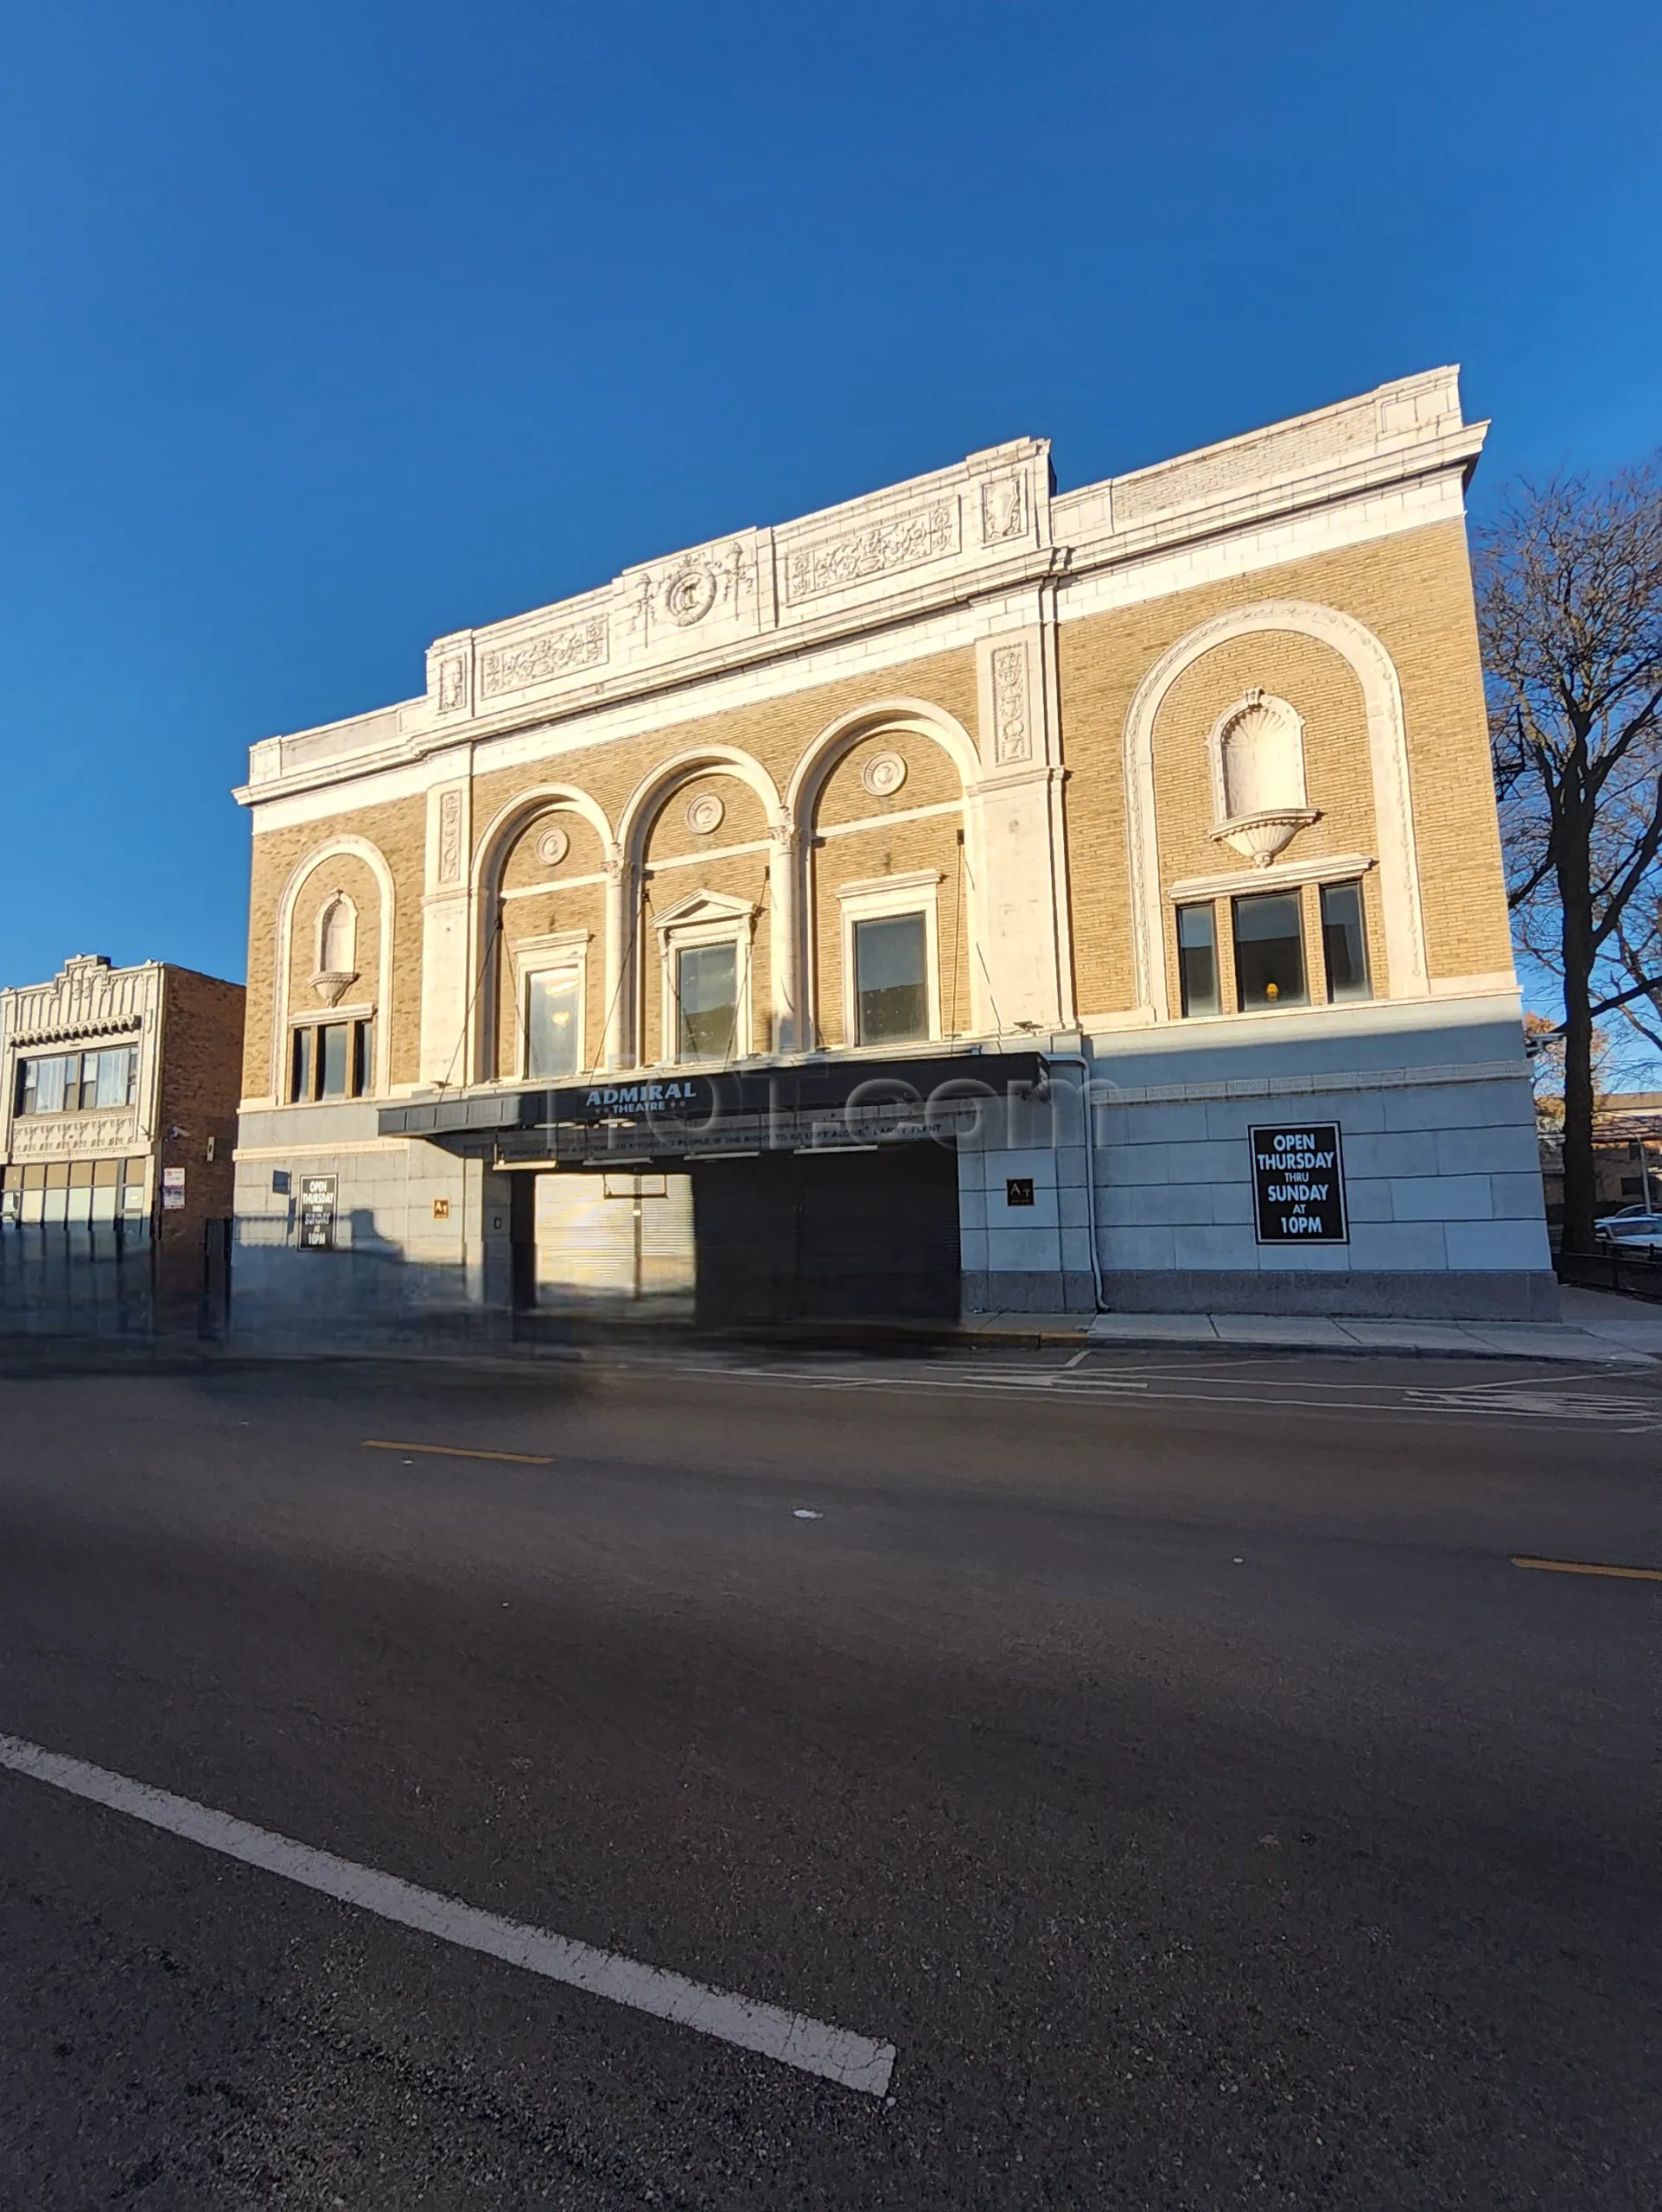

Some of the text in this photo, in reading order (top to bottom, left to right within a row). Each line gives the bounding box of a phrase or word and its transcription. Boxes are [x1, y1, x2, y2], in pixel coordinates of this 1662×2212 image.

[586, 1082, 697, 1106] ADMIRAL
[612, 1101, 665, 1114] THEATRE
[873, 1126, 906, 1135] LARY
[1273, 1134, 1315, 1151] OPEN
[1257, 1152, 1334, 1170] THURSDAY
[1284, 1172, 1309, 1182] THRU
[309, 1180, 328, 1192] OPEN
[1268, 1185, 1329, 1202] SUNDAY
[1292, 1204, 1307, 1214] AT
[1281, 1217, 1322, 1233] 10PM
